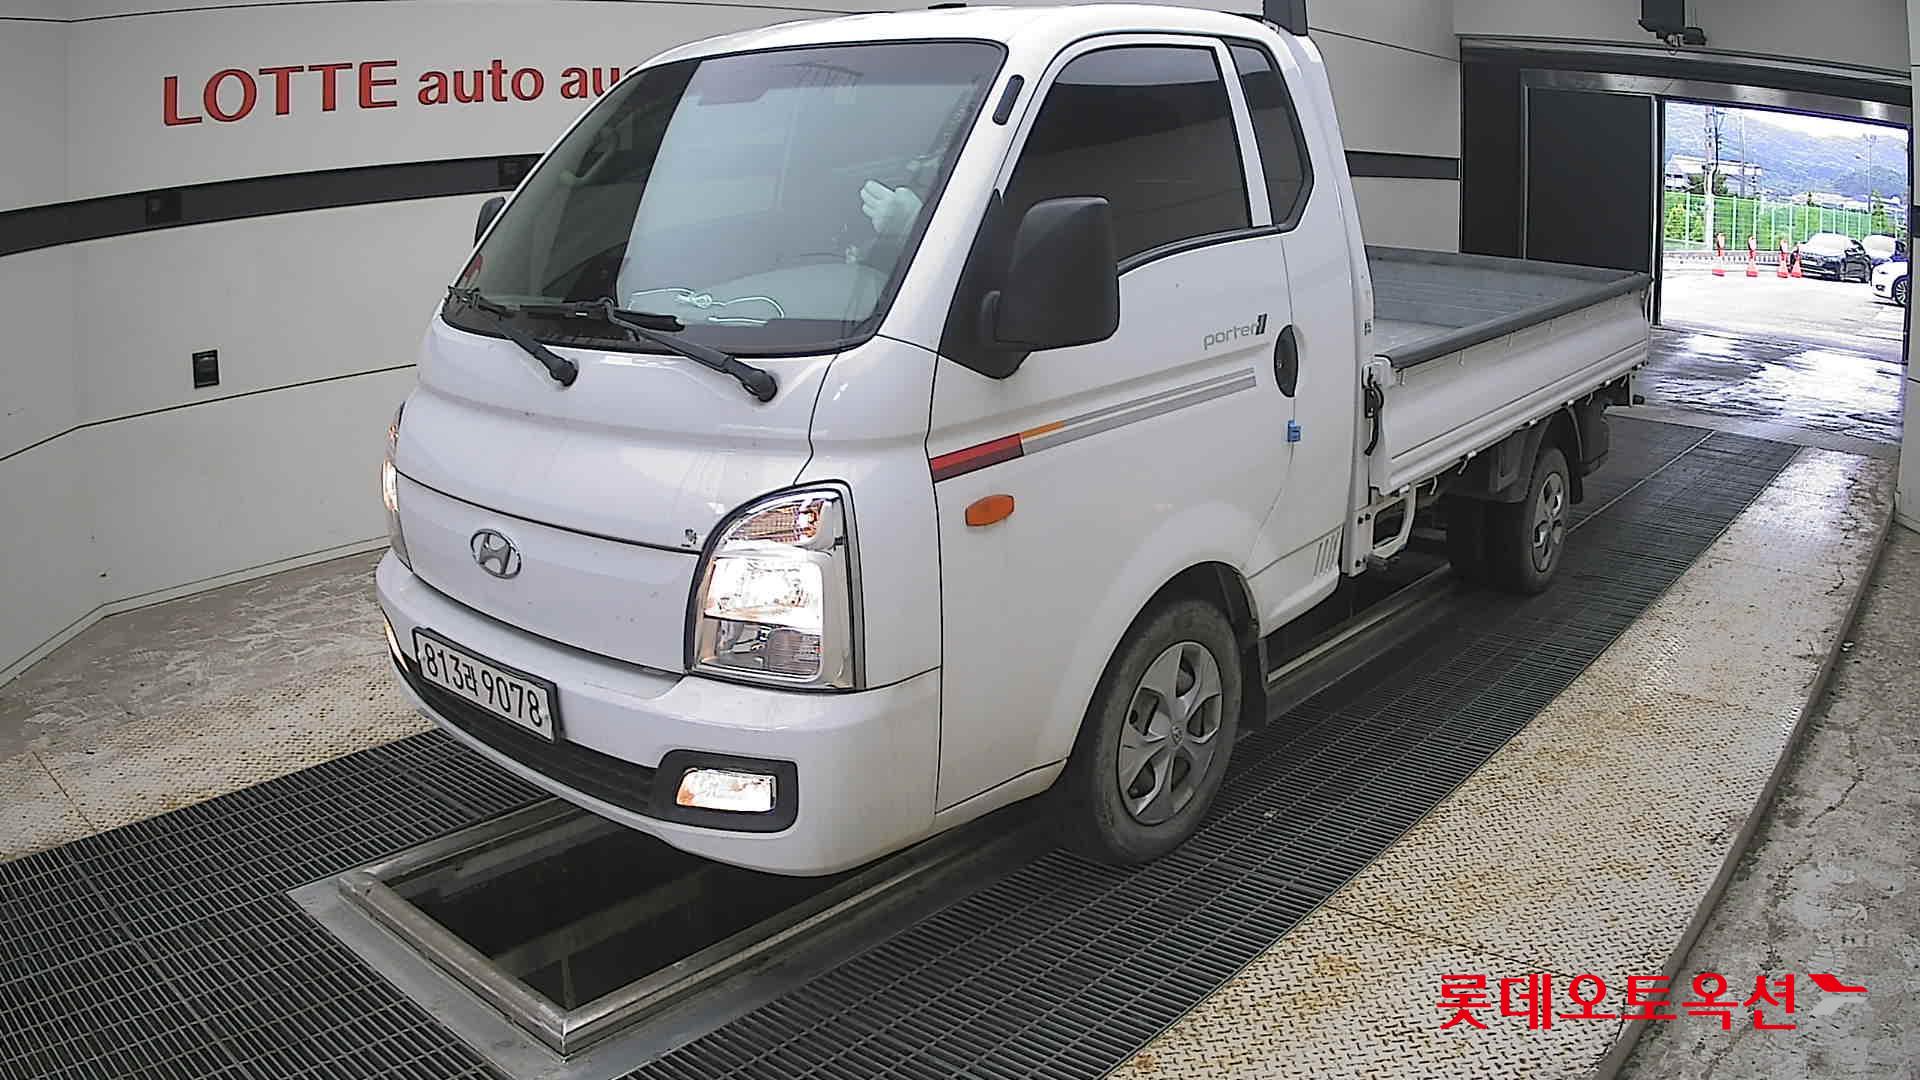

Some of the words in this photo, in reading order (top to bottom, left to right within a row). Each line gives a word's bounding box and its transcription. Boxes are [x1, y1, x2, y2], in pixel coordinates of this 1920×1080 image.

[163, 60, 398, 126] LOTTE
[417, 59, 546, 105] auto
[561, 66, 638, 99] au
